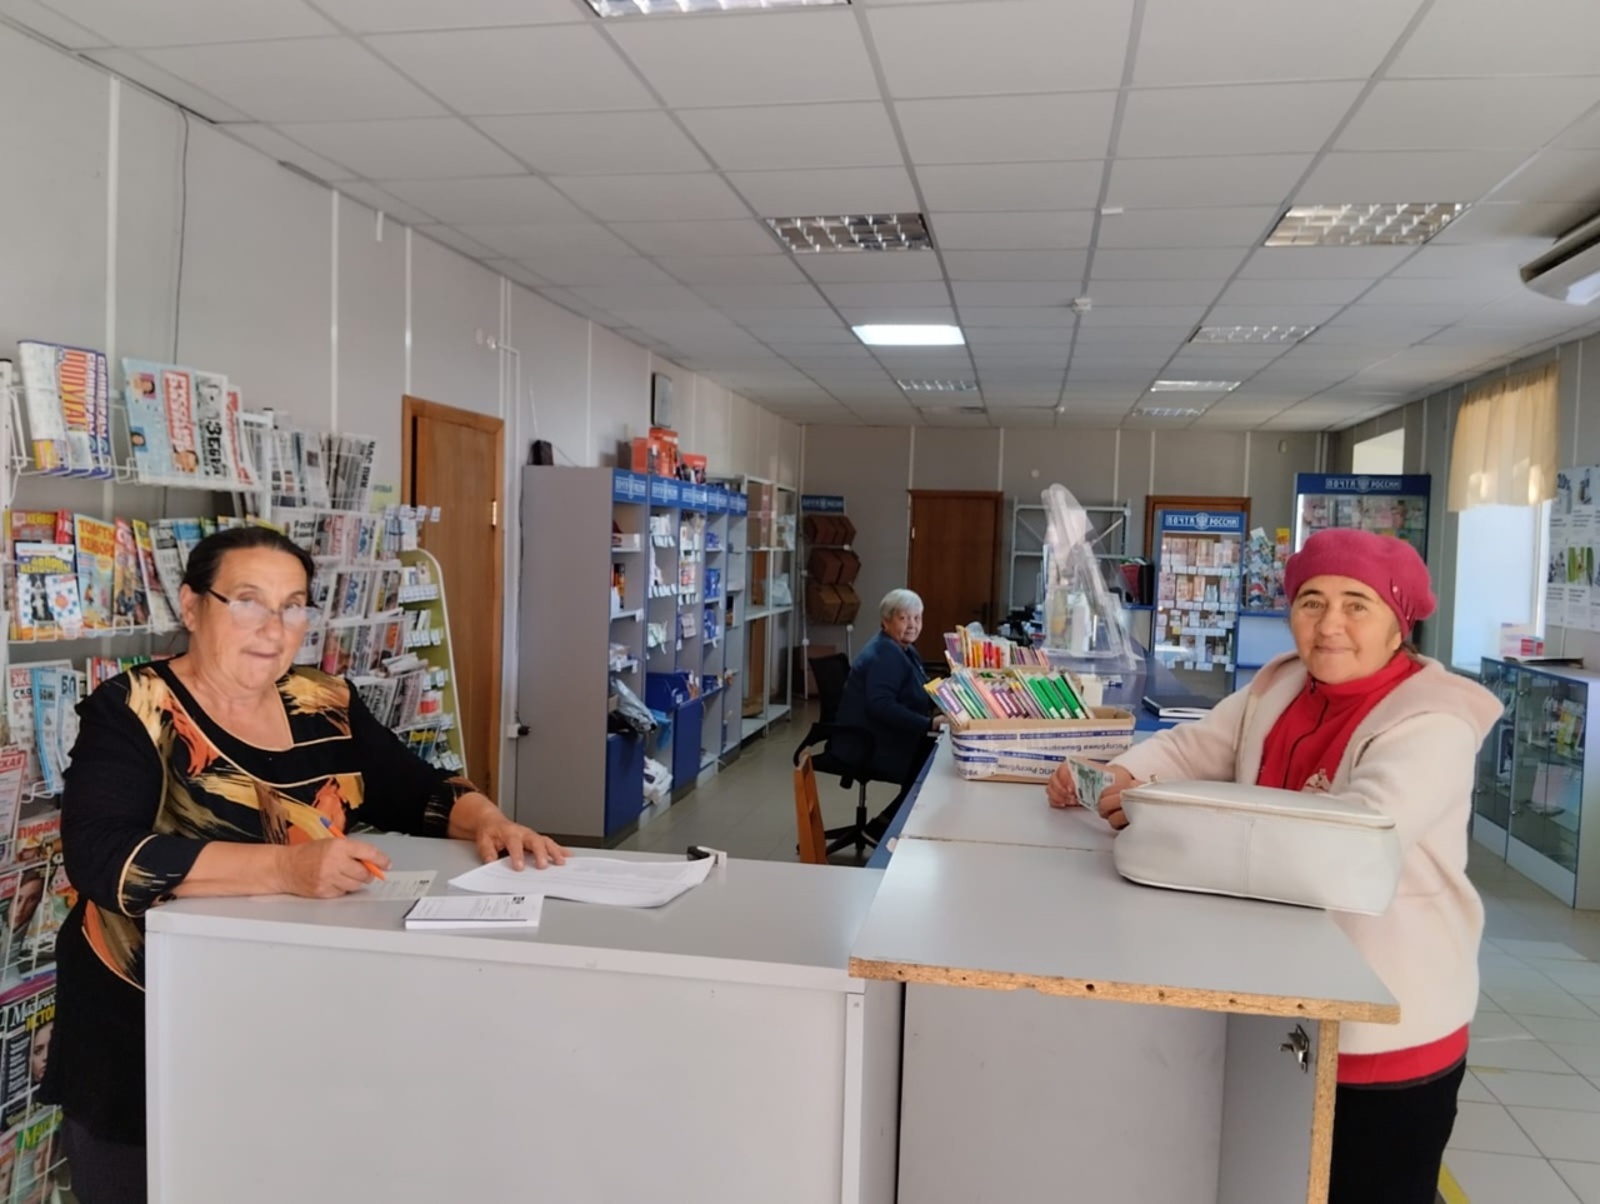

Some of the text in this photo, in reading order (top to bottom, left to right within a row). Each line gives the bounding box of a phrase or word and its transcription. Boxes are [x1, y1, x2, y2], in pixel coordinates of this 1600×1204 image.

[359, 465, 371, 490] ПИК
[1326, 480, 1356, 489] ПОЧТА
[1166, 515, 1196, 526] ПОЧТА
